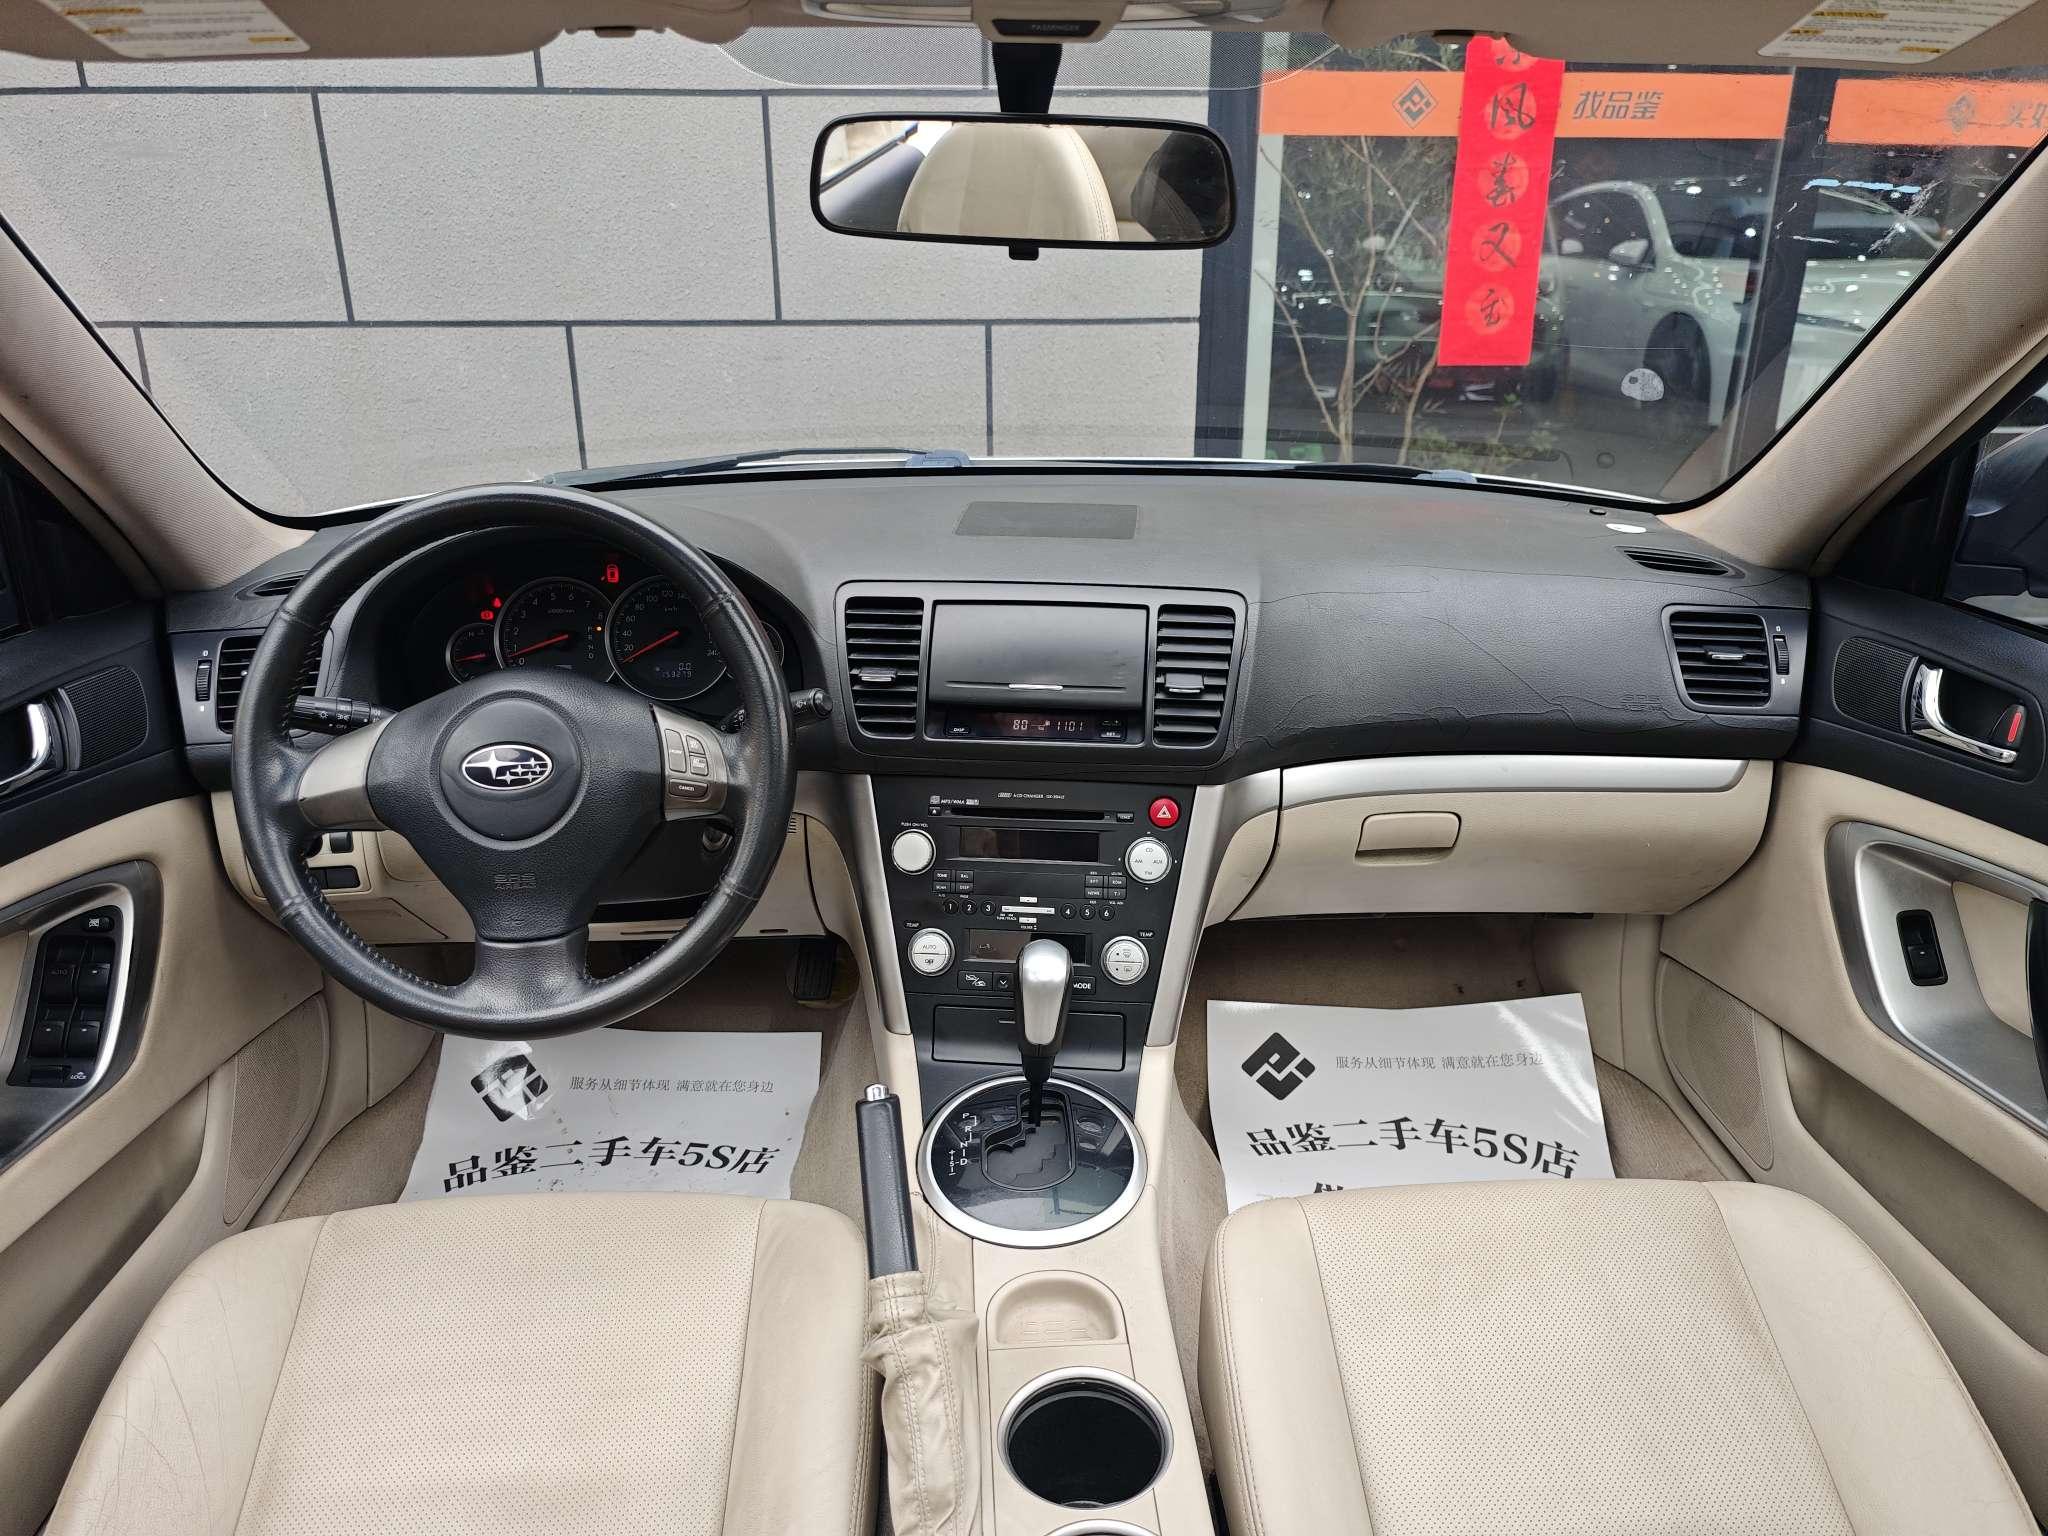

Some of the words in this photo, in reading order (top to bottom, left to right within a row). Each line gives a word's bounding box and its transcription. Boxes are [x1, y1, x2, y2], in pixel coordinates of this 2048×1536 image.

[624, 643, 634, 651] 20
[1012, 719, 1029, 731] 80
[1335, 1055, 1436, 1070] 服务从细节体现
[568, 1075, 671, 1092] 服务从细节体现
[675, 1079, 774, 1094] 满意就在您身边
[1245, 1116, 1581, 1179] 品鉴二手车5S店
[443, 1135, 781, 1193] 品鉴二手车5S店
[959, 1158, 968, 1166] D
